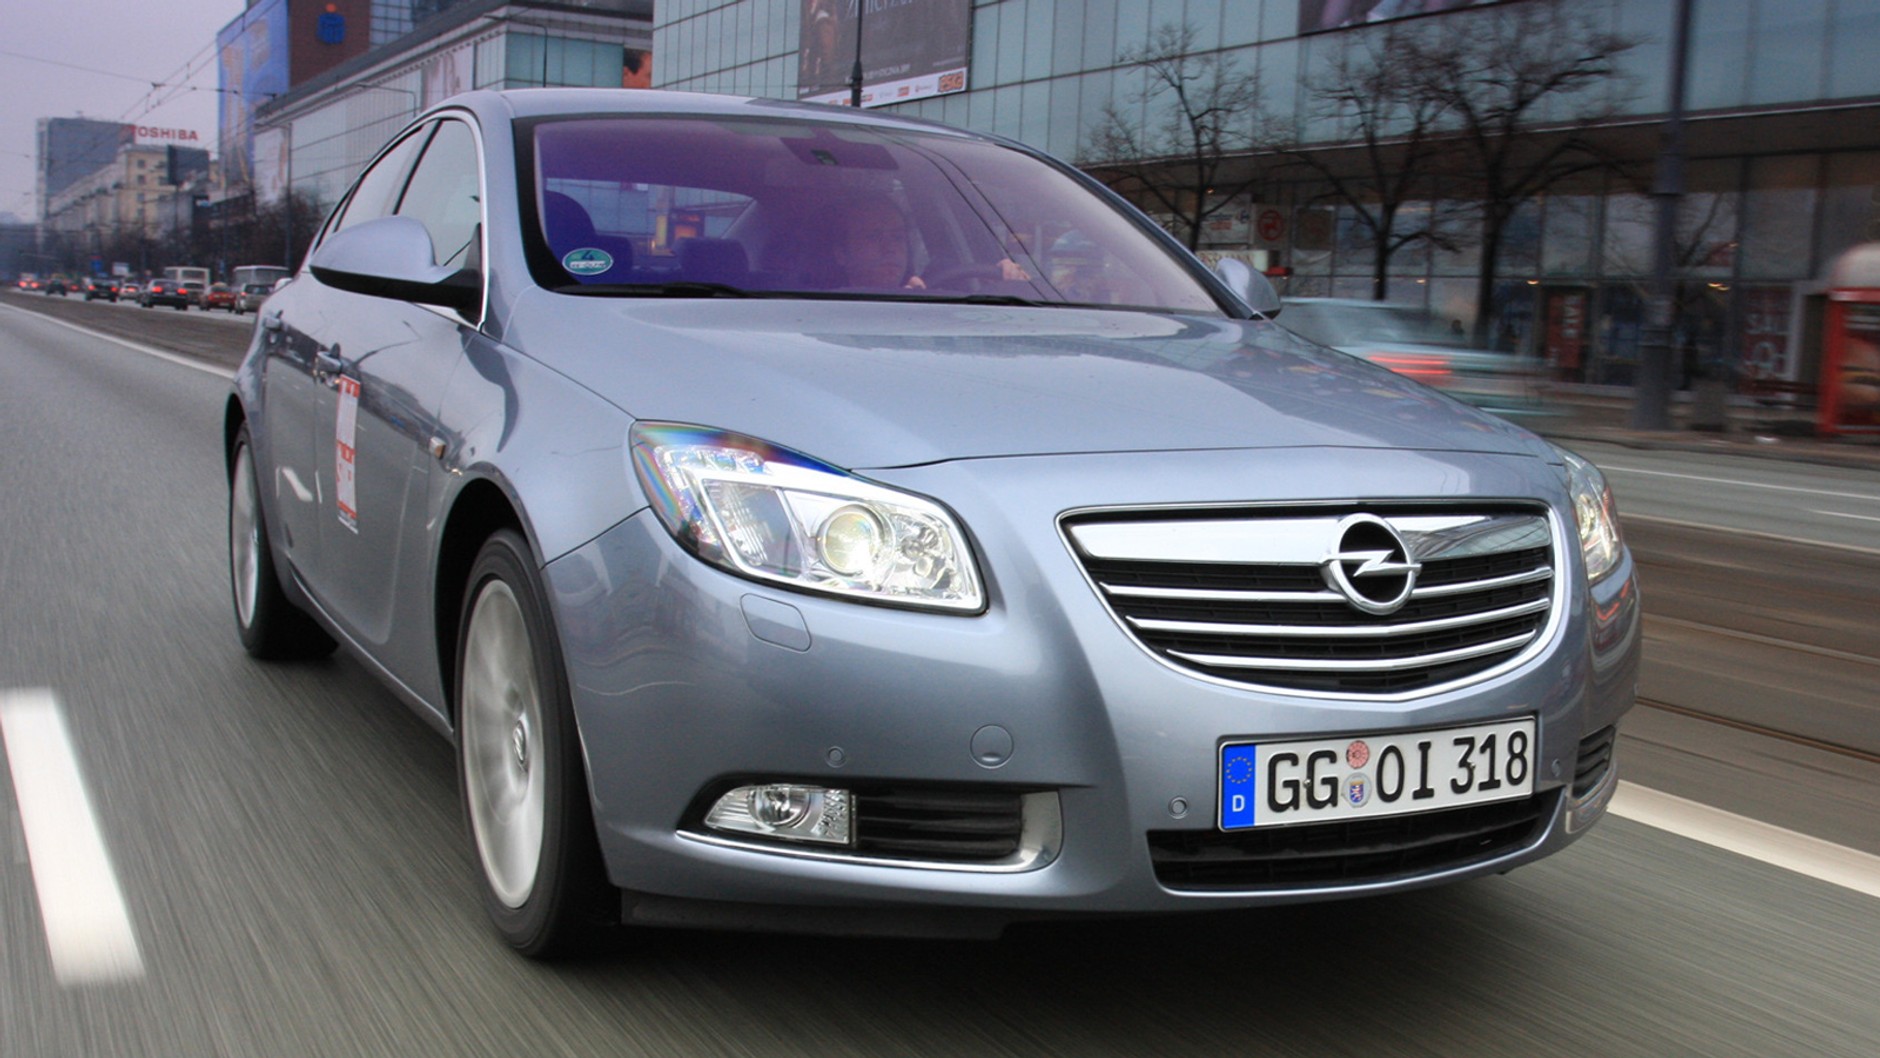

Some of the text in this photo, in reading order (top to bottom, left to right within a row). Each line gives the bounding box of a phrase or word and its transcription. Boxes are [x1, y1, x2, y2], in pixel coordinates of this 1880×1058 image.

[1267, 729, 1528, 813] GG OI 318
[1232, 794, 1246, 813] D
